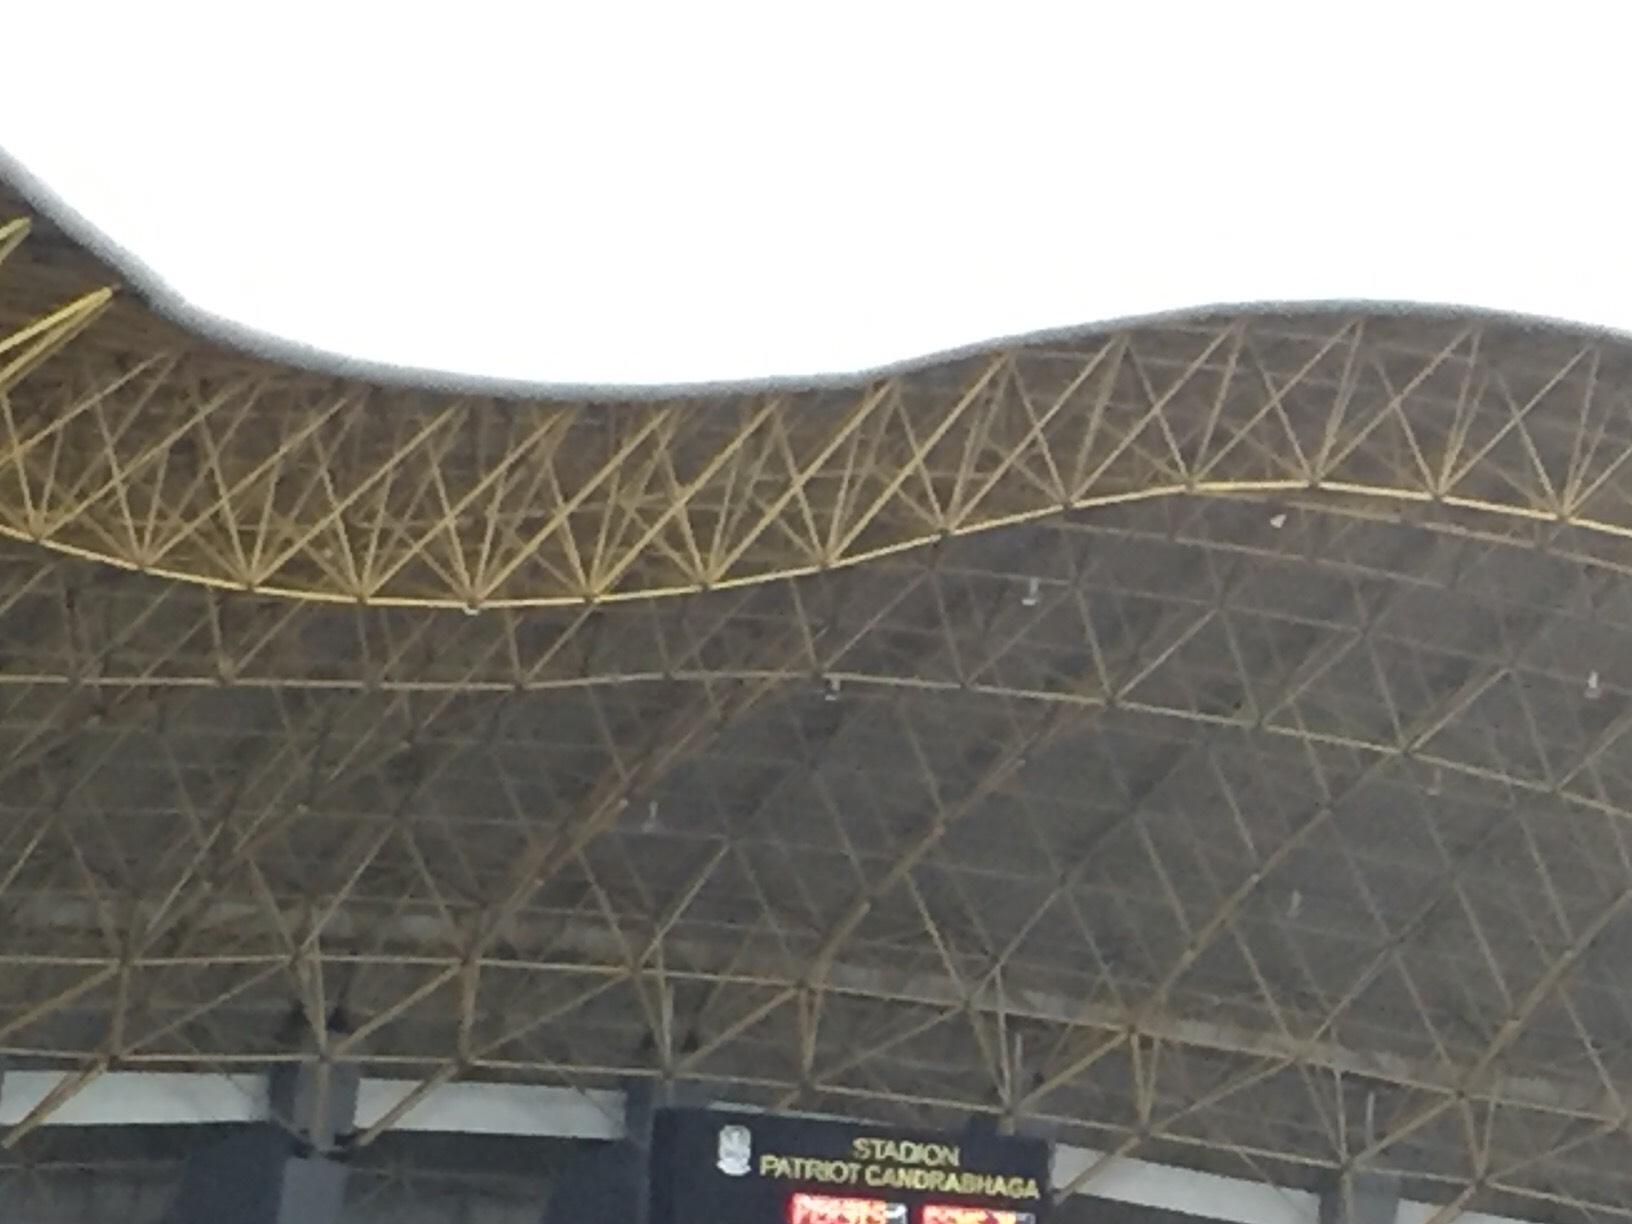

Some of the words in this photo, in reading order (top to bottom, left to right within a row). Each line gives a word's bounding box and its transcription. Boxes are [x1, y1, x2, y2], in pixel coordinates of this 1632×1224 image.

[853, 1137, 959, 1167] STADION
[760, 1154, 859, 1185] PATRIOT
[865, 1164, 1039, 1199] CANDRABHAGA
